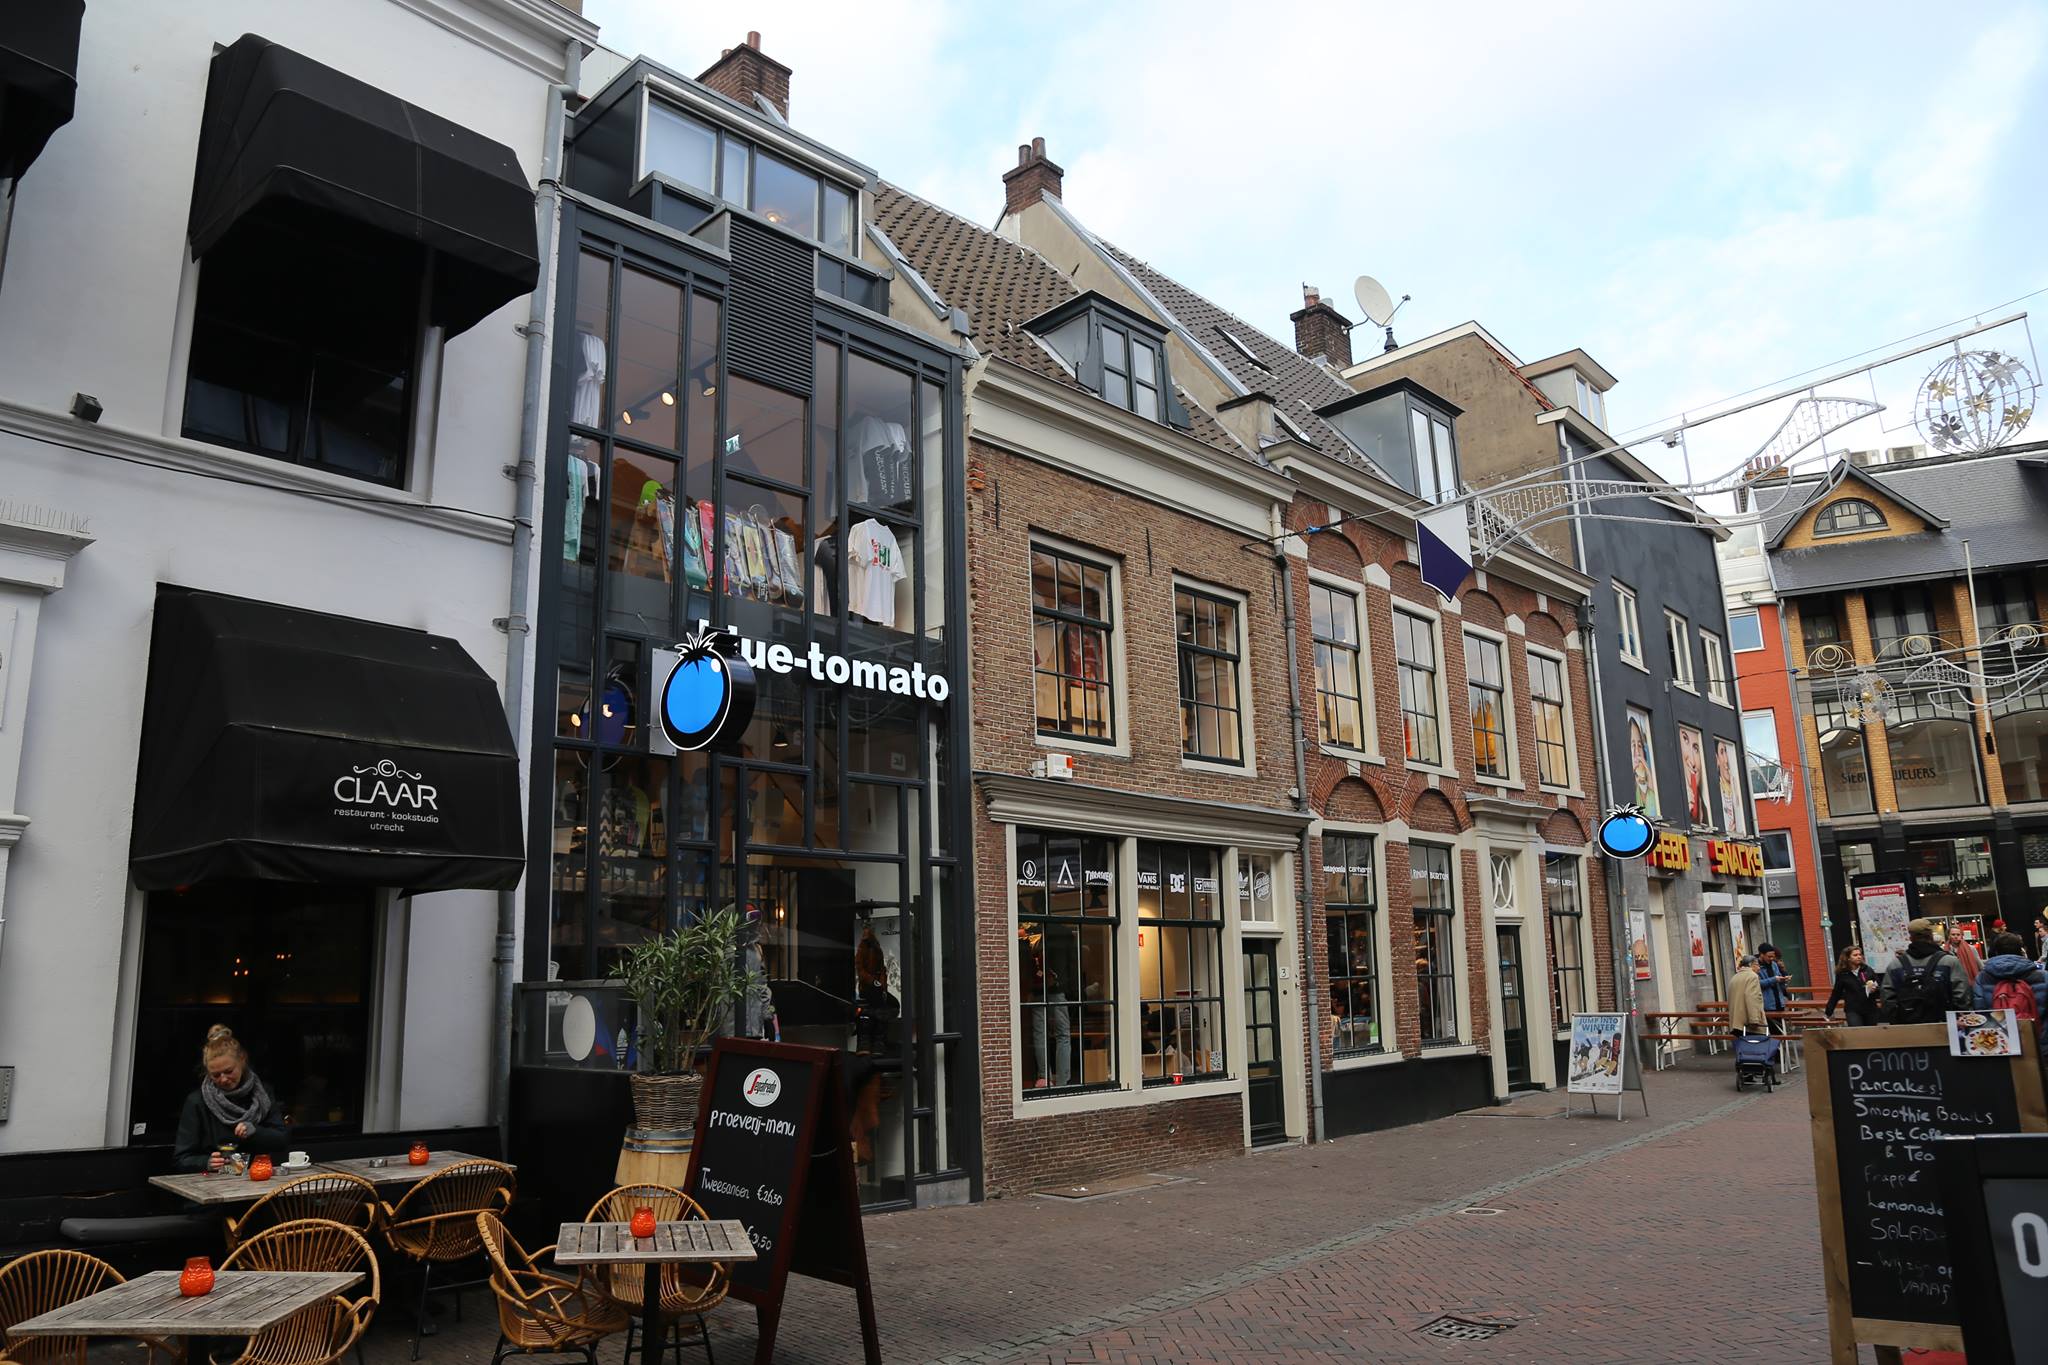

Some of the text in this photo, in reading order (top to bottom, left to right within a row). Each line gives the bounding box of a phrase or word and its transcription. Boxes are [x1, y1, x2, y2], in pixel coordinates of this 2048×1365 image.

[698, 618, 950, 702] ue-tomato
[333, 775, 438, 811] CLAAR
[334, 808, 385, 819] restaurant
[391, 813, 439, 824] kookstudio
[370, 823, 405, 832] utrecht
[1712, 840, 1765, 877] SNACKS
[1016, 878, 1046, 887] VOLCOM
[1137, 872, 1157, 885] VANS
[1579, 1017, 1599, 1026] JUMP
[1582, 1023, 1616, 1031] WINTER
[1848, 1063, 1943, 1095] Pancakes!
[1853, 1098, 1931, 1122] Smoothie
[709, 1110, 796, 1137] Proeverij-menu
[1860, 1125, 1906, 1142] Best
[1903, 1145, 1936, 1161] Tea
[1867, 1190, 1945, 1216] Lemonade
[1870, 1217, 1947, 1240] SALAD
